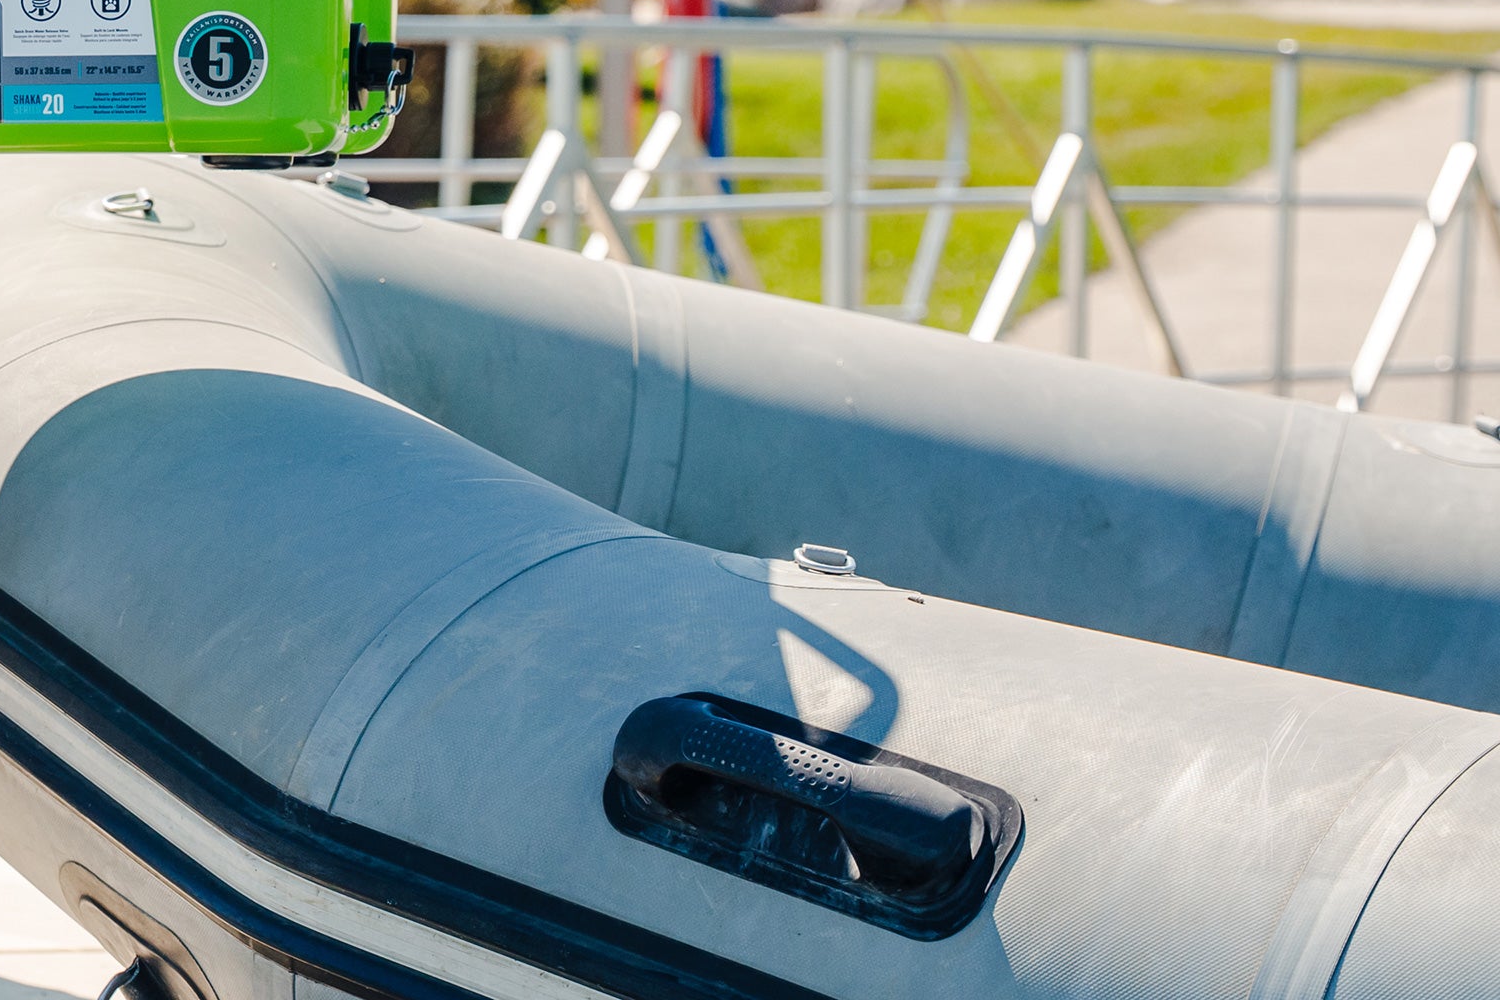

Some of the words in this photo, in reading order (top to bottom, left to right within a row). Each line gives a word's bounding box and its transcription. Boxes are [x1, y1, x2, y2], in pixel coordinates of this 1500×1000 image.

[186, 18, 258, 46] KAILANISPORTS.COM
[208, 36, 234, 82] 5
[182, 62, 201, 90] YEAR
[206, 64, 259, 98] WARRANTY
[13, 94, 41, 105] SHAKA
[41, 93, 64, 115] 20
